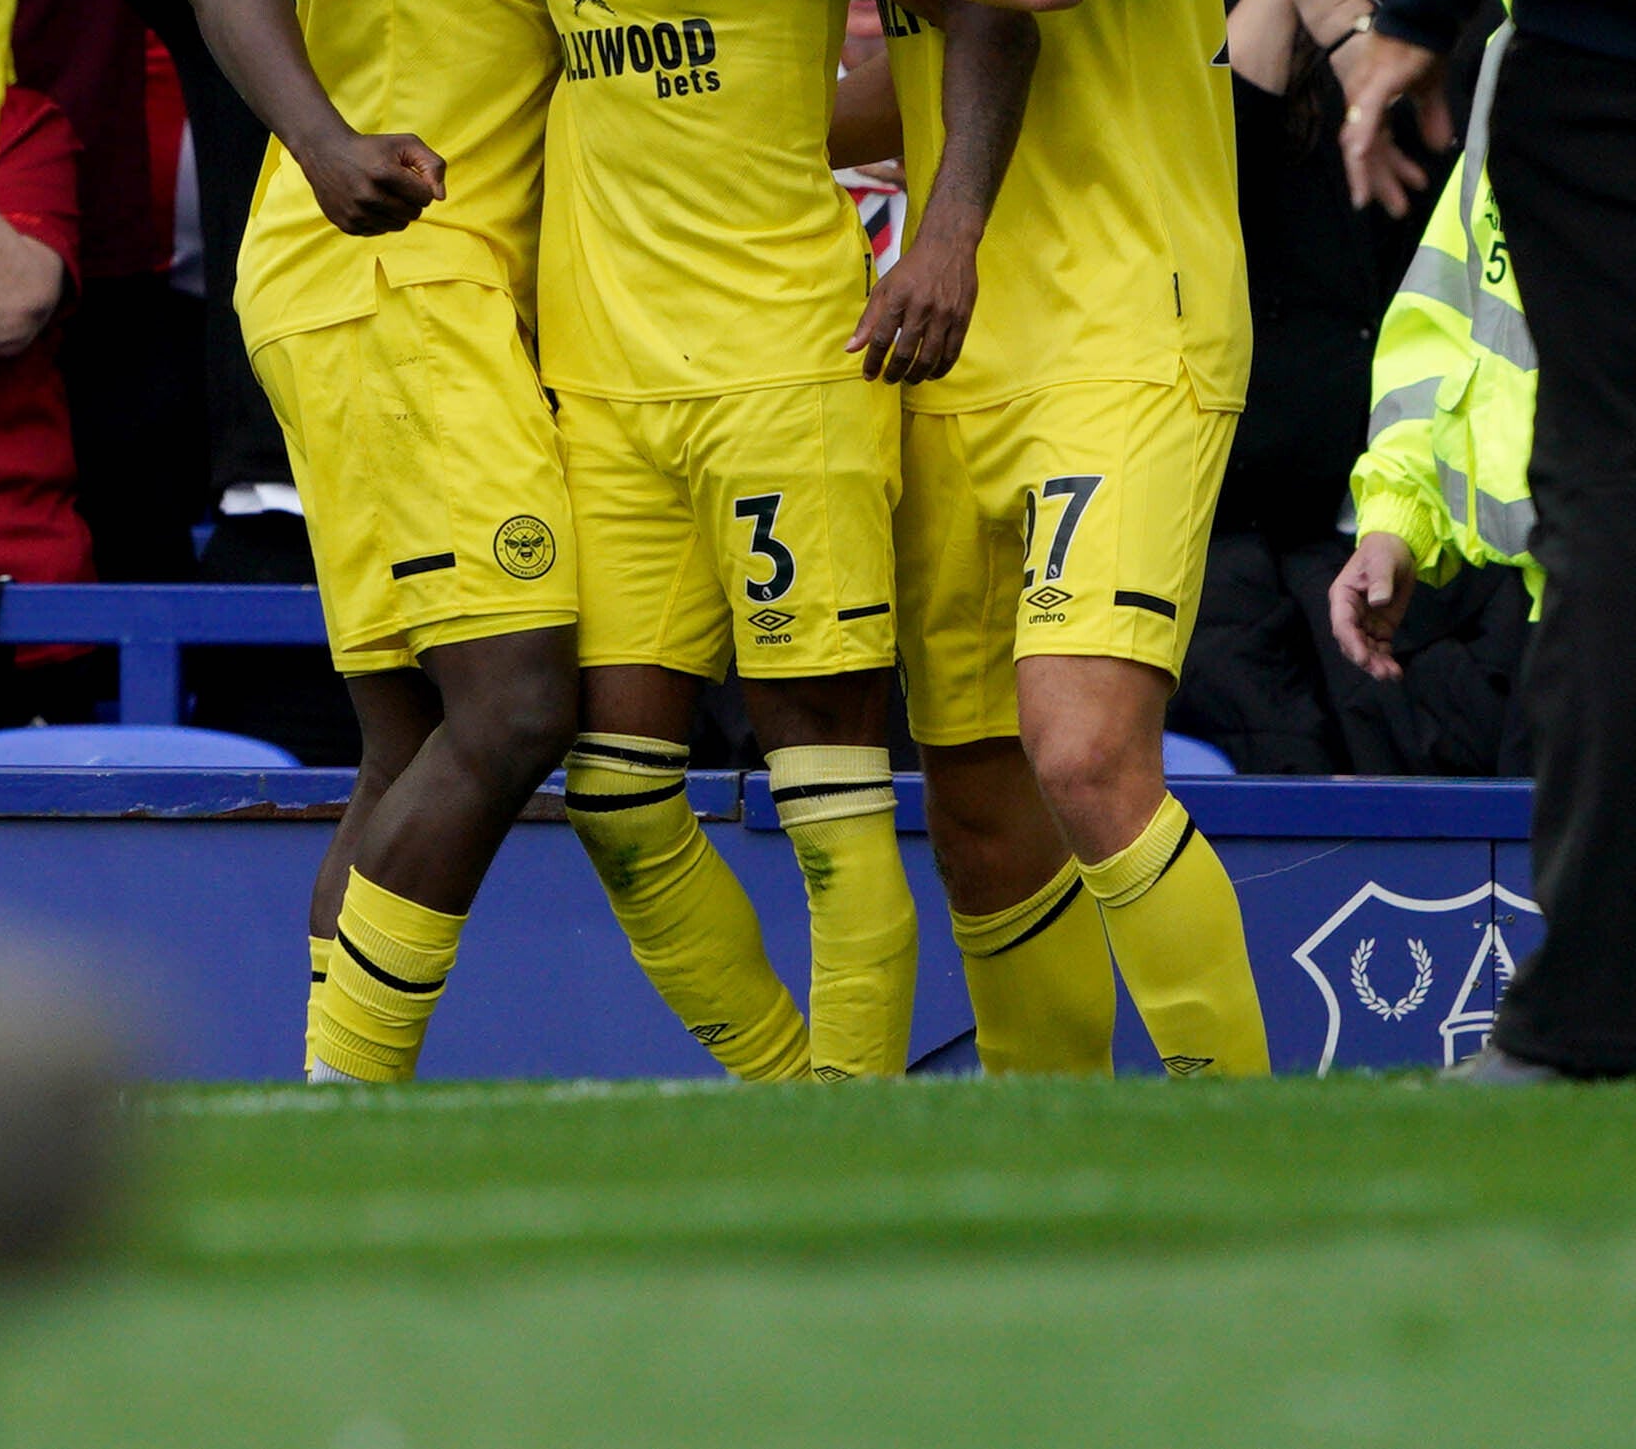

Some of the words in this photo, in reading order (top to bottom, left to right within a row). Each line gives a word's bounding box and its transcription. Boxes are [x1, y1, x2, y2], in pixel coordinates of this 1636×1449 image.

[655, 70, 721, 99] bets
[734, 492, 797, 604] 3
[1028, 611, 1066, 625] umbro
[755, 633, 793, 646] umbro
